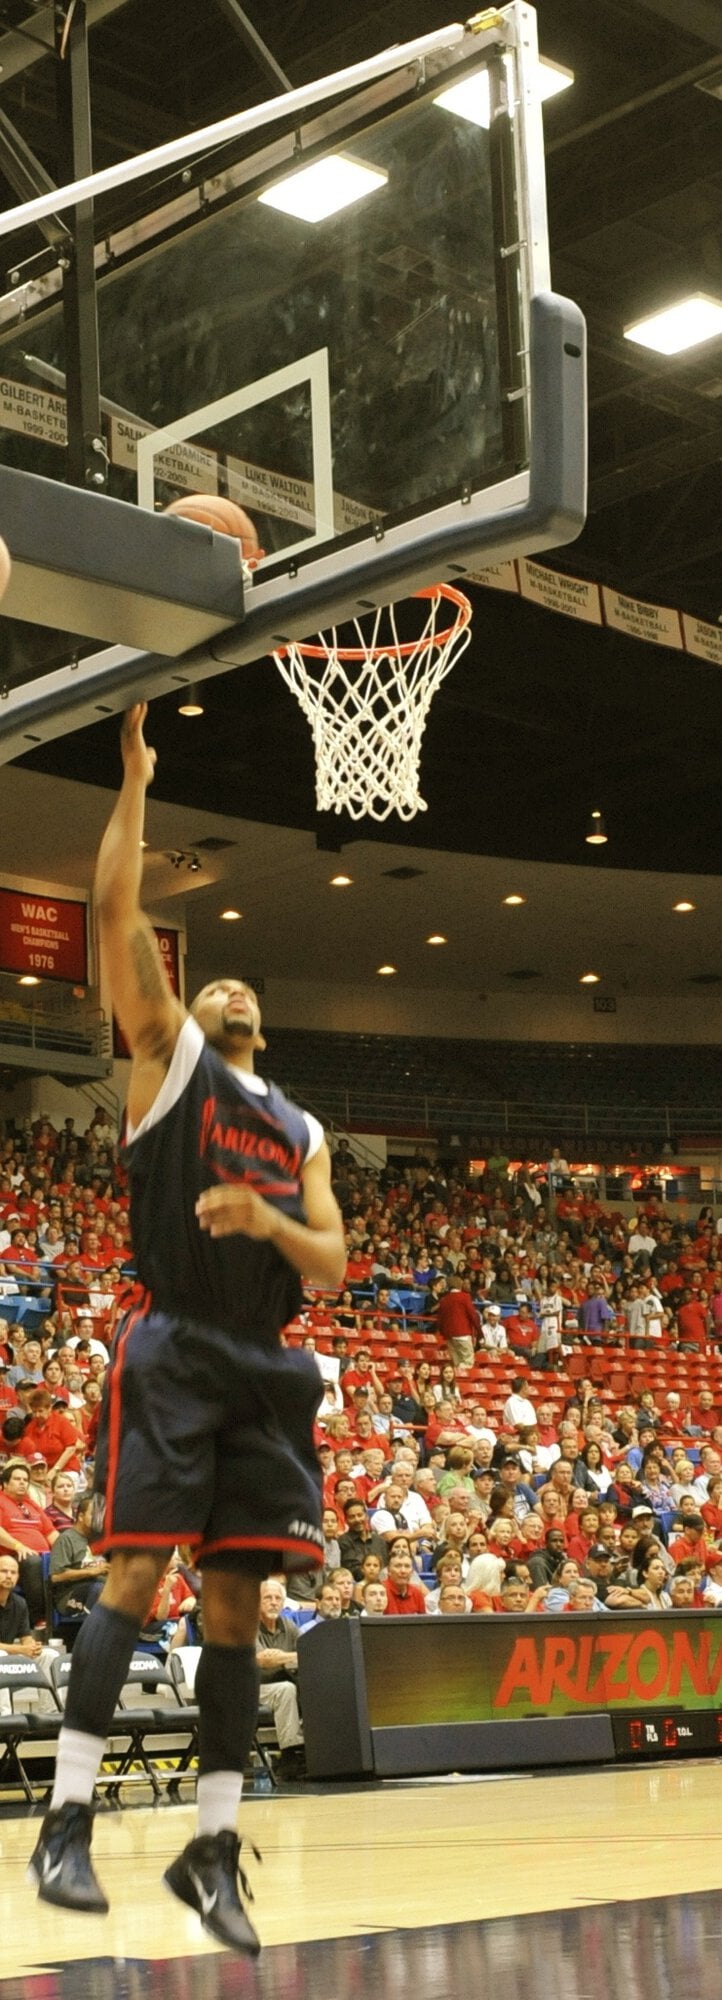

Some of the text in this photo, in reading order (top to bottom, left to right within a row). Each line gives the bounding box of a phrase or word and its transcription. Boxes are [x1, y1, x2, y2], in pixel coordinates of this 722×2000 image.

[0, 381, 45, 409] GILBERT
[3, 401, 66, 430] M-BASKETB
[245, 466, 307, 497] LUKE WALTON
[526, 563, 589, 596] MICHAEL WRIGHT
[21, 902, 58, 923] WAC
[10, 923, 70, 942] MEN'S BASKETBALL
[23, 935, 60, 950] CHAMPIONS
[28, 953, 55, 970] 1976
[211, 1121, 302, 1177] ARIZONA
